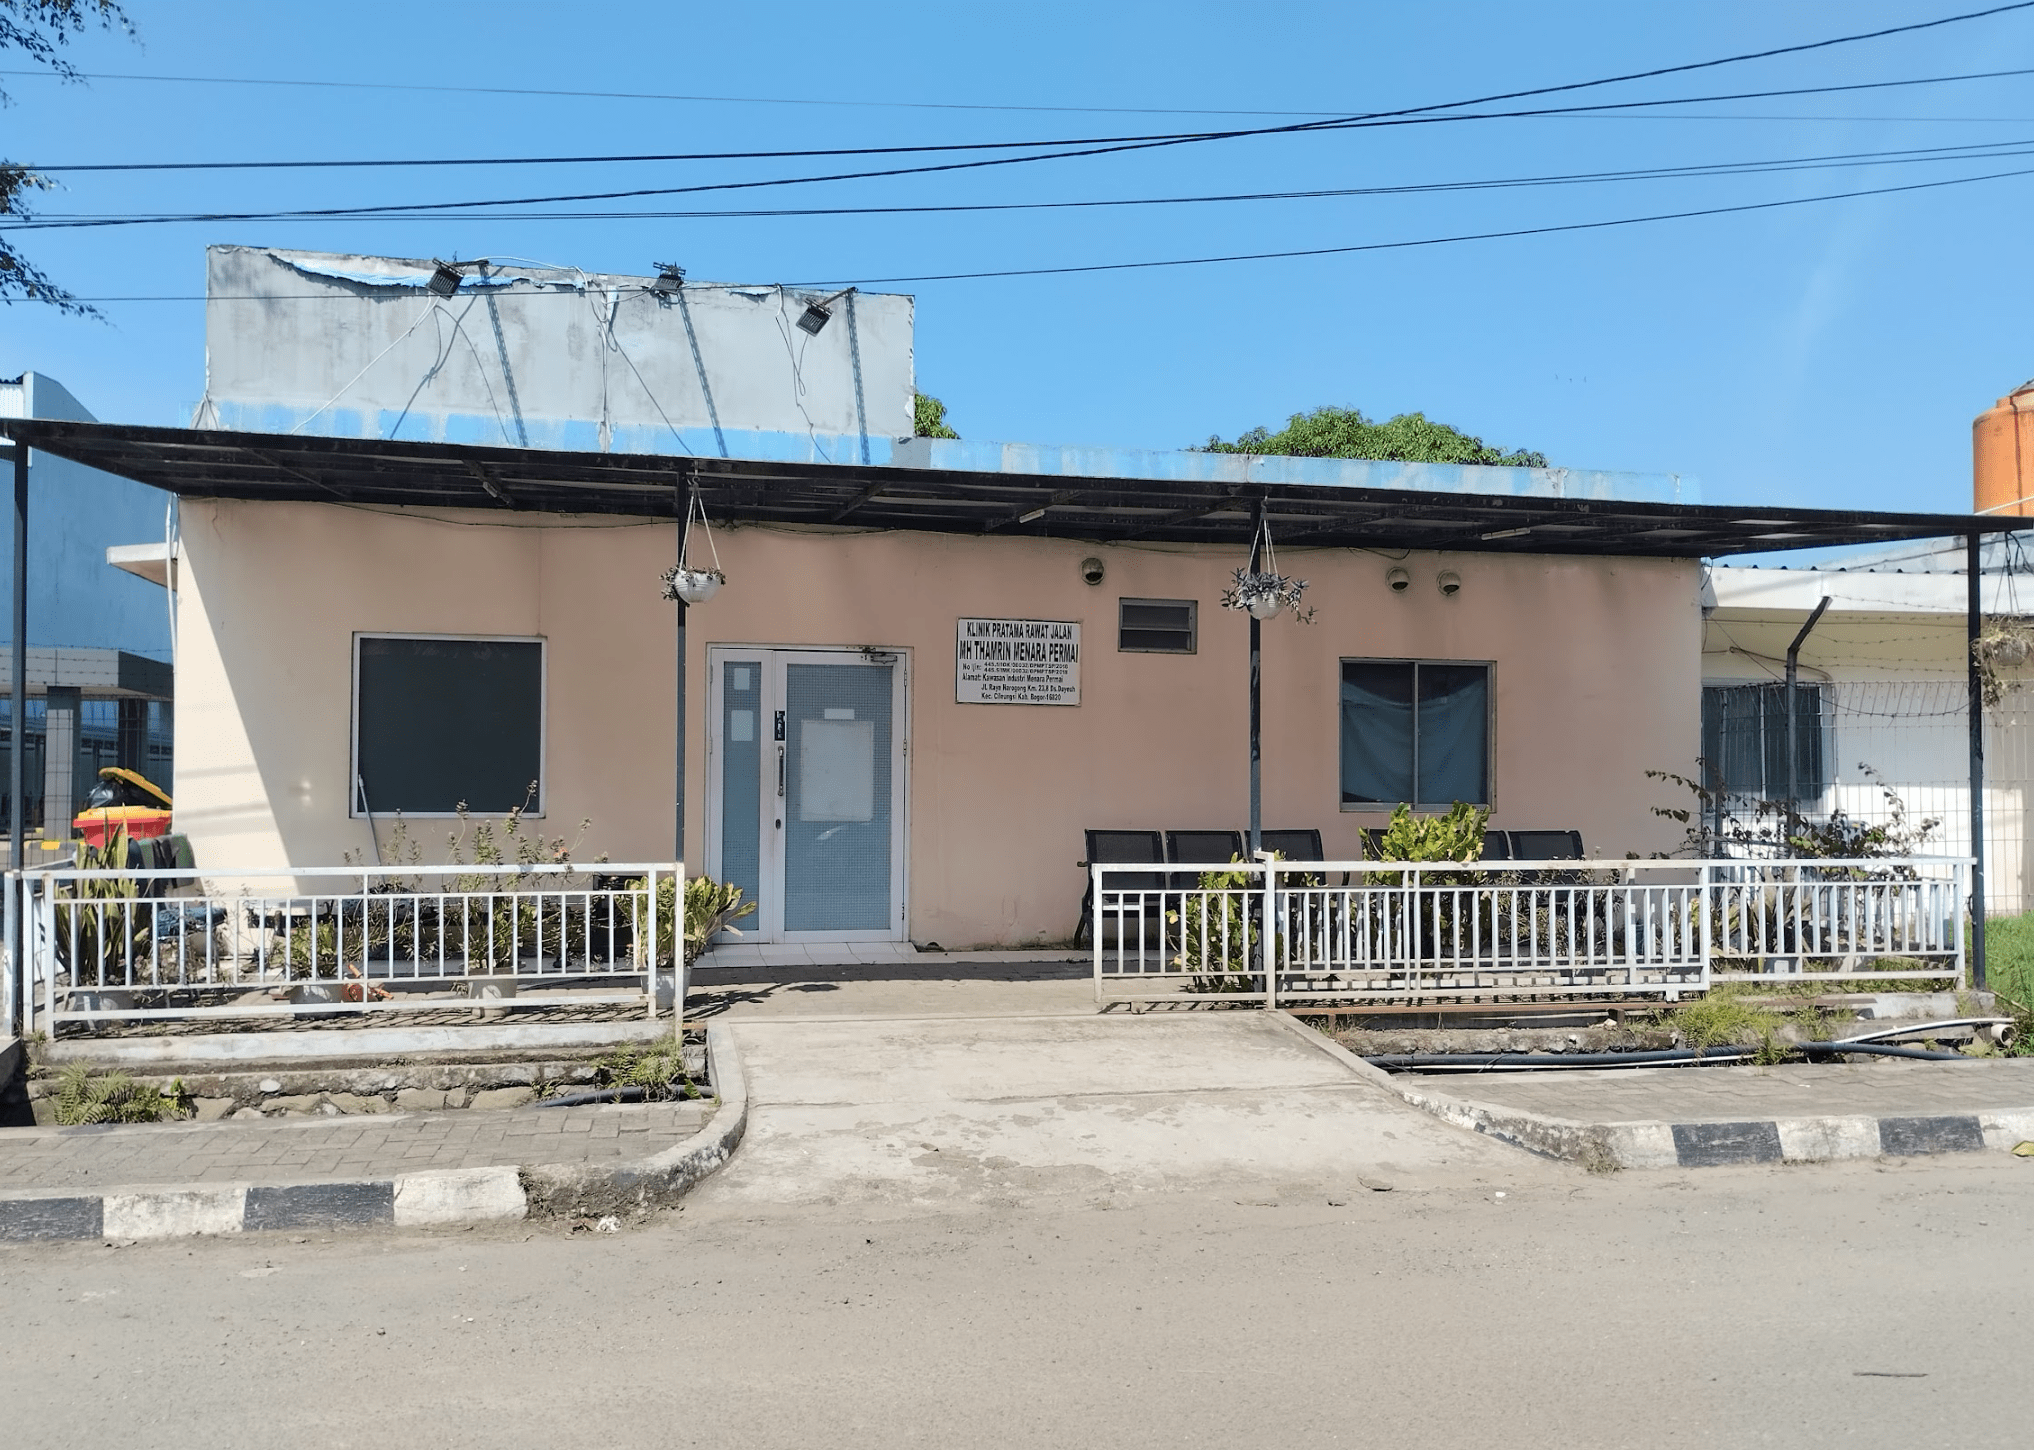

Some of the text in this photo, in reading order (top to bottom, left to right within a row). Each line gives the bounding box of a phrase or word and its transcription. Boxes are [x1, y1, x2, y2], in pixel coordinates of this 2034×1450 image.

[967, 621, 1072, 640] KLINIK PRATAMA RAWAT JALAN
[960, 640, 1078, 663] MH THAMRIN MENARA PERMAI
[983, 673, 1005, 681] Kawasan
[1027, 674, 1045, 682] Menara
[989, 684, 1001, 692] Raya
